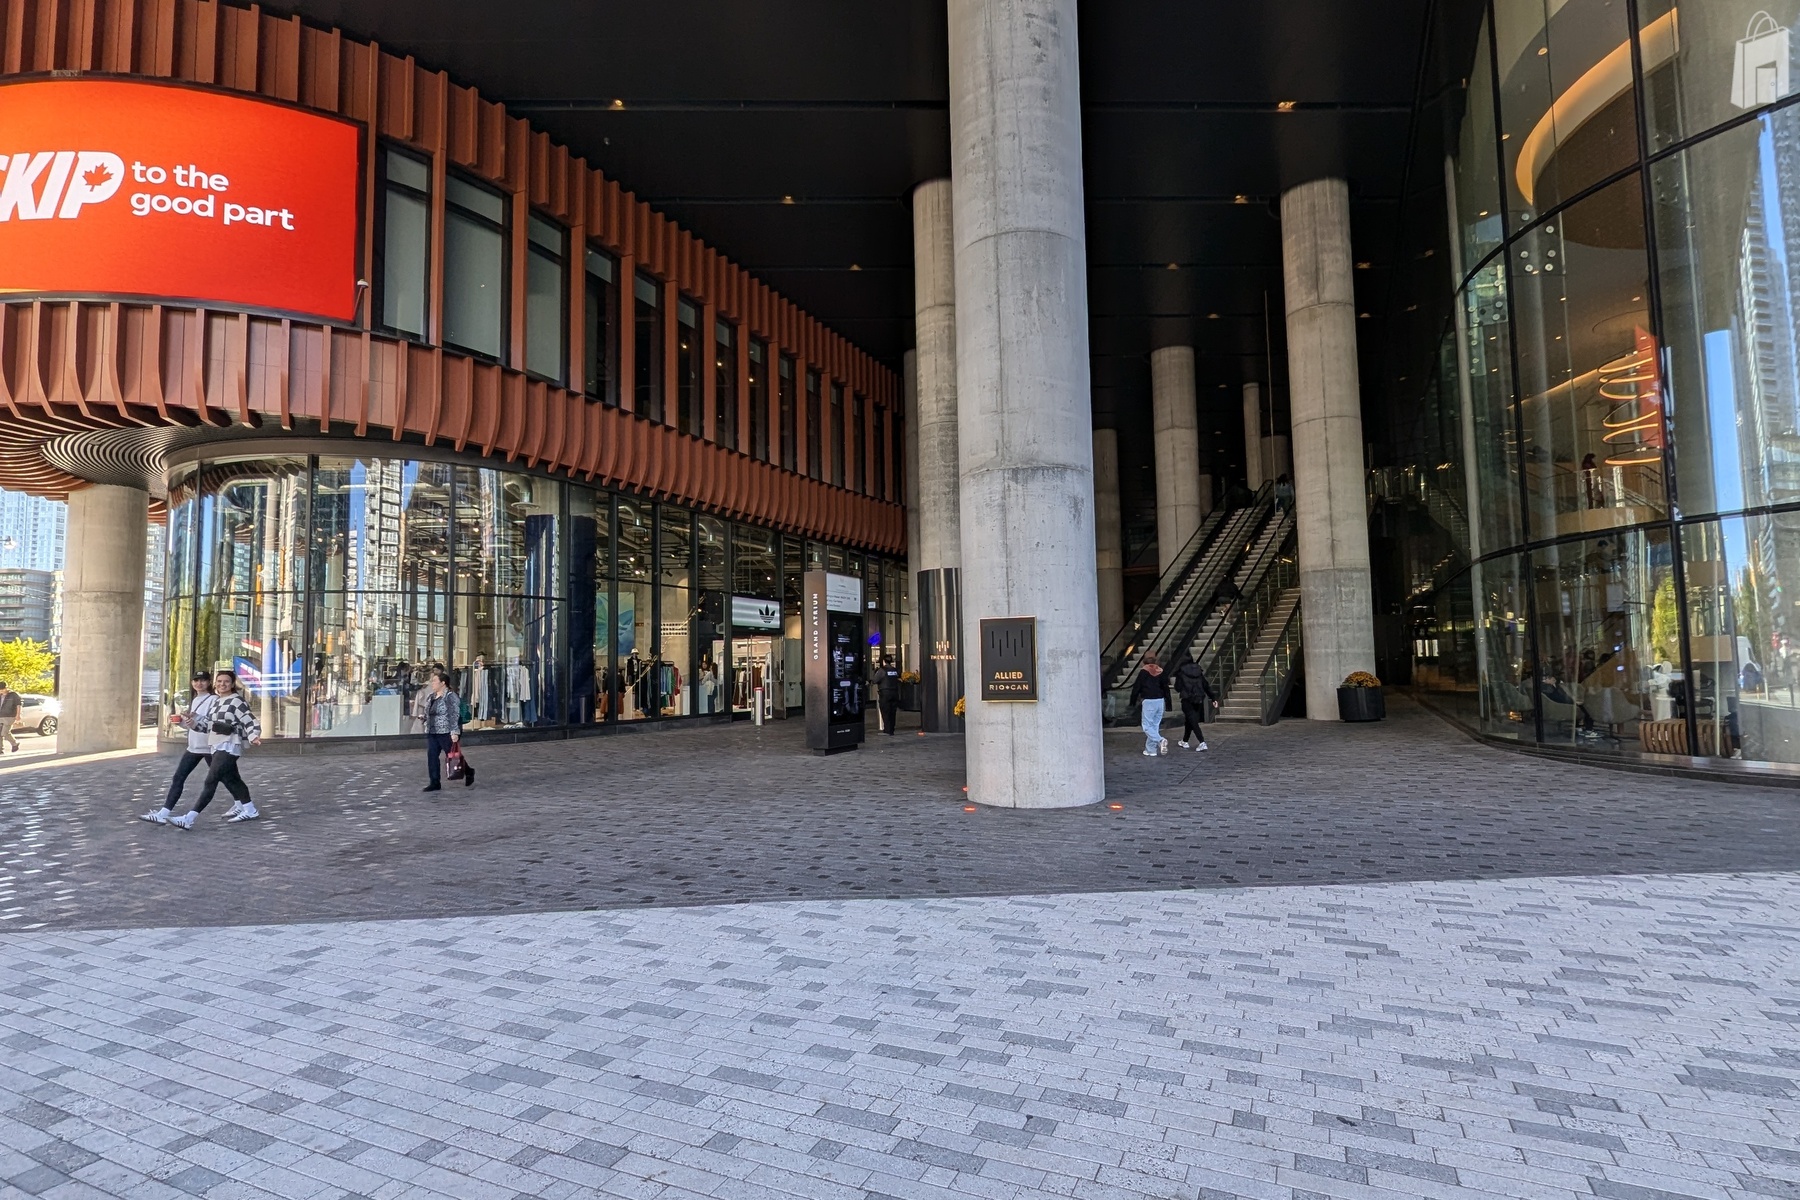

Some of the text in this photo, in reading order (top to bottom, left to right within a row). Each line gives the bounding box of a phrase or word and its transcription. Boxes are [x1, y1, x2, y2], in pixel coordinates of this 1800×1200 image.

[131, 160, 229, 192] to the
[130, 190, 295, 231] good part
[994, 671, 1023, 680] ALLIED
